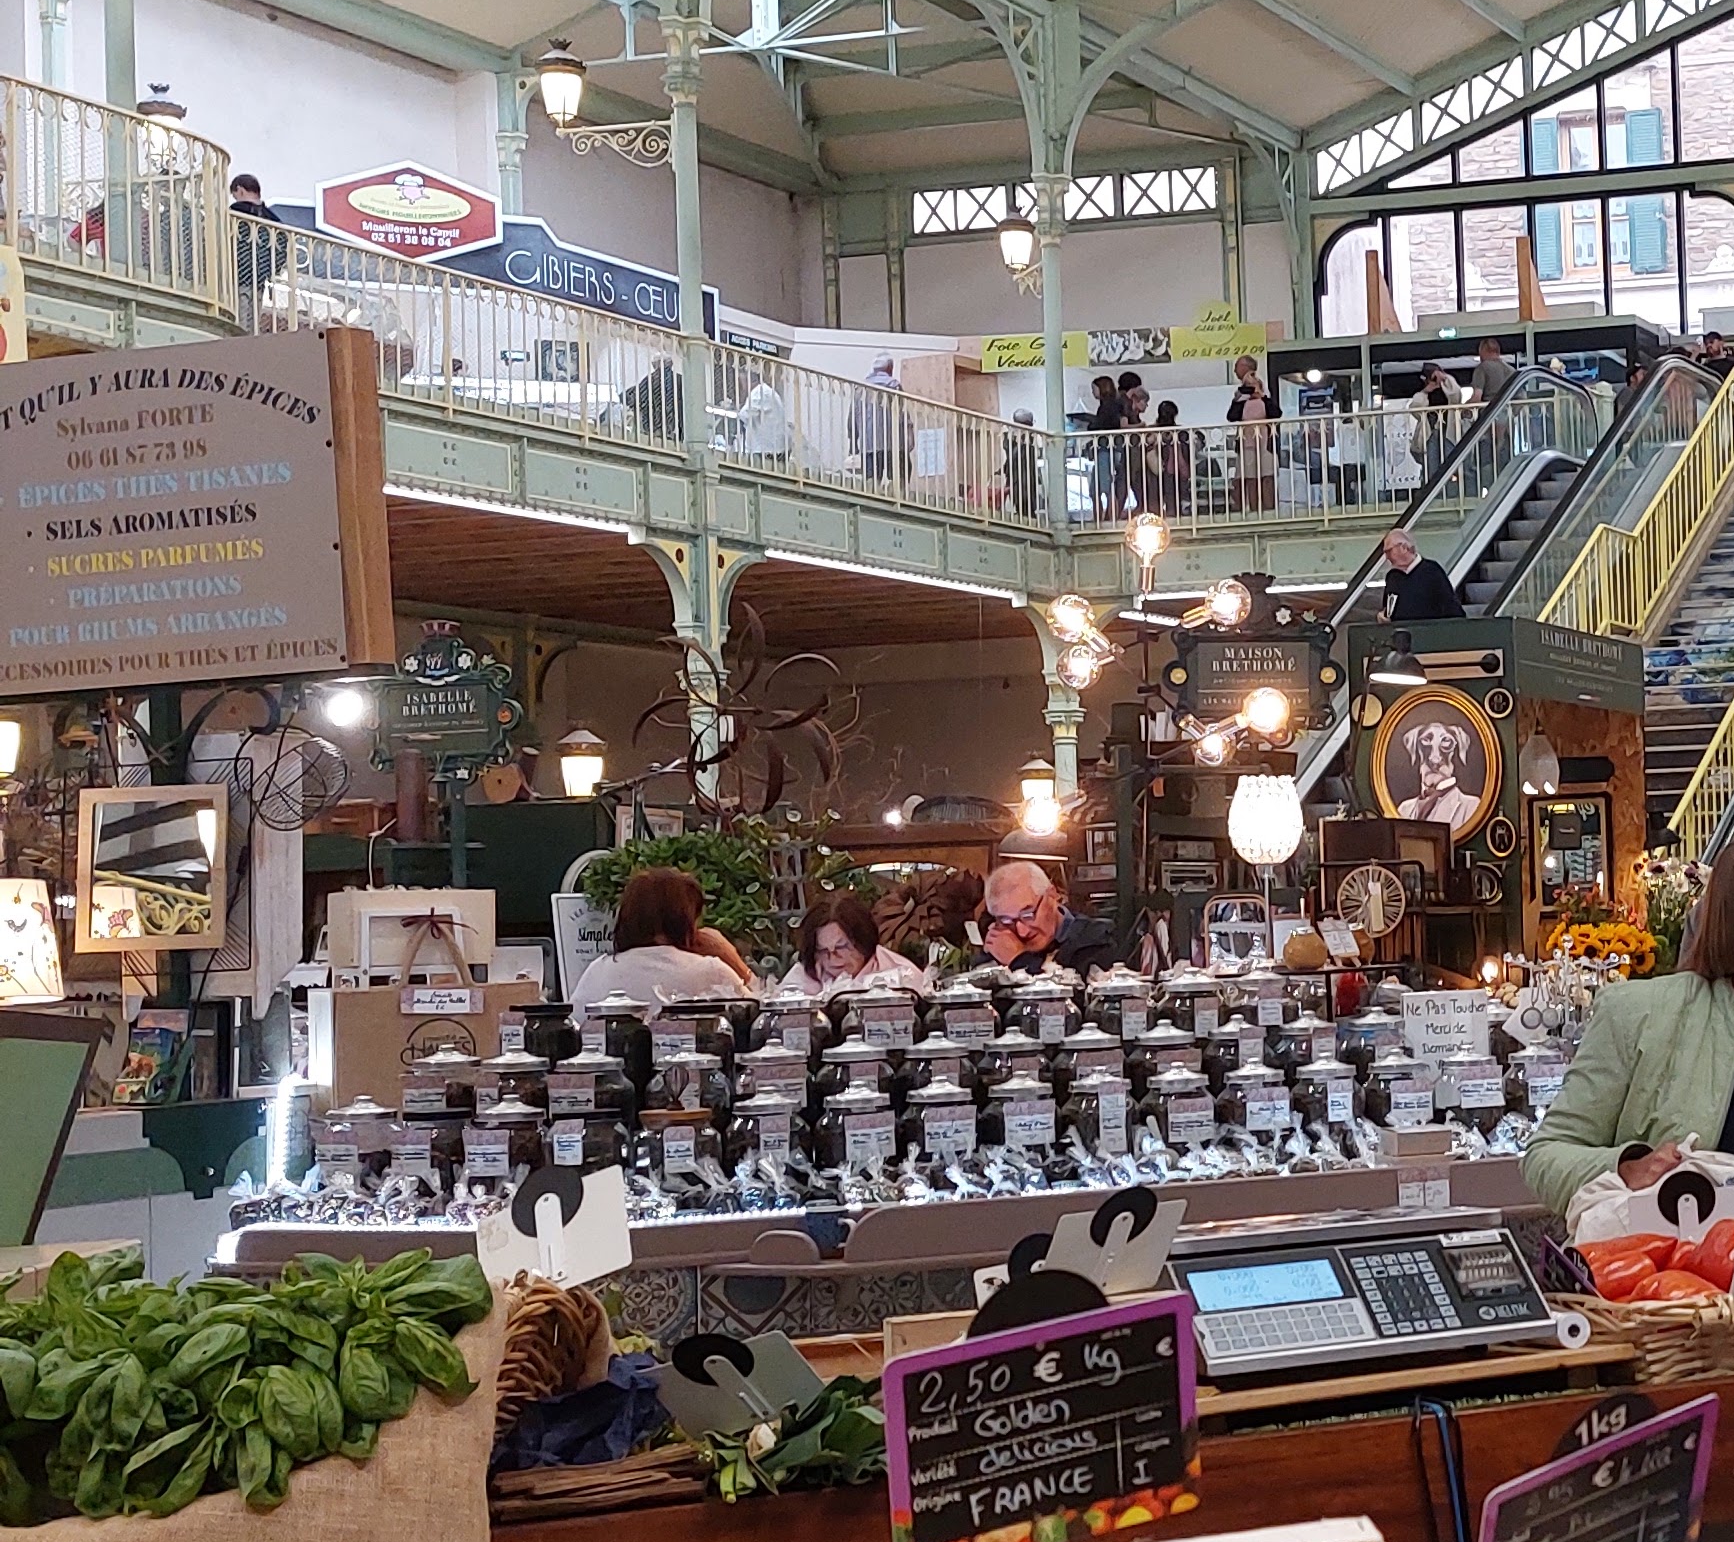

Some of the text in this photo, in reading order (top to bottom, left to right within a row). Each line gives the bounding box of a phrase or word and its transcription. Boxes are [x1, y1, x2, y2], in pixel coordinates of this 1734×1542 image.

[417, 224, 428, 236] le
[505, 250, 615, 305] GIBIERS
[986, 339, 1021, 352] Foie
[20, 382, 81, 425] QU'IL
[89, 375, 102, 395] Y
[107, 368, 170, 394] AURA
[178, 368, 228, 394] DES
[229, 373, 321, 425] ÉPICES
[56, 404, 214, 442] Sylvana FORTE
[67, 439, 207, 470] 06 61 87 73 98
[18, 462, 292, 508] ÉPICES THÉS TISANES
[46, 502, 257, 541] SELS AROMATISÉS
[47, 536, 264, 577] SUCRES PARFUMÉS
[67, 574, 242, 608] PRÉPARATIONS
[9, 604, 287, 647] POUR RHUMS ARRANGÉS
[119, 651, 170, 674] POUR
[175, 643, 228, 667] THÉS
[235, 644, 259, 662] ET
[267, 637, 338, 660] ÉPICES
[1224, 646, 1284, 659] MAISON
[406, 689, 472, 704] ISABELLE
[1406, 999, 1488, 1016] Ne Pas Toucher
[1426, 1023, 1450, 1035] Merci
[918, 1360, 1011, 1414] 2,50
[1033, 1351, 1063, 1382] €
[1084, 1343, 1122, 1386] Kg
[908, 1399, 1070, 1442] Produit Golden
[1574, 1404, 1627, 1447] 1kg
[913, 1489, 963, 1513] Origine
[969, 1466, 1094, 1527] FRANCE
